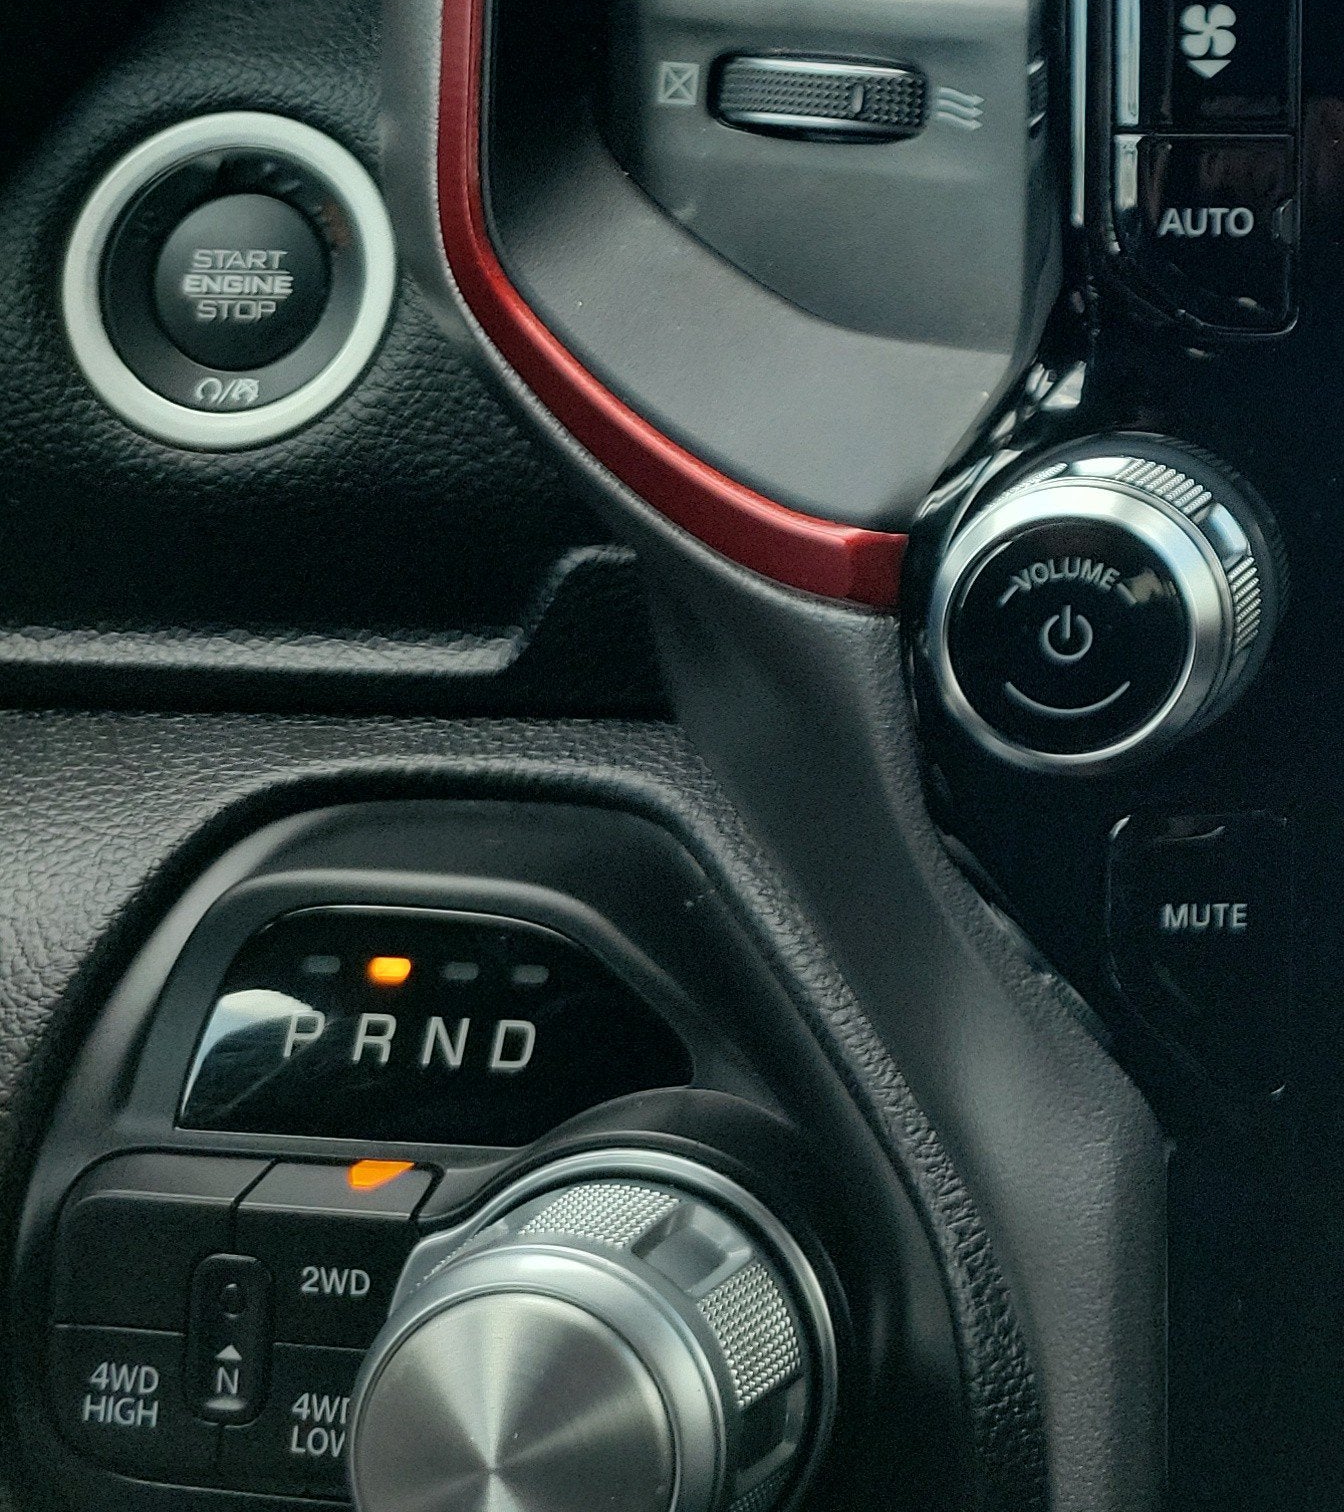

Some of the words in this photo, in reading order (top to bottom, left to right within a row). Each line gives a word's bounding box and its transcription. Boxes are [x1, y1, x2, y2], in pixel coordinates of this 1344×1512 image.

[1158, 207, 1255, 237] AUTO
[193, 249, 287, 270] START
[182, 274, 293, 295] ENGINE
[196, 300, 276, 321] STOP
[1011, 556, 1121, 592] VOLUME
[1162, 903, 1248, 929] MUTE
[300, 1266, 370, 1296] 2WD
[89, 1361, 160, 1394] 4WD
[82, 1393, 160, 1428] HIGH
